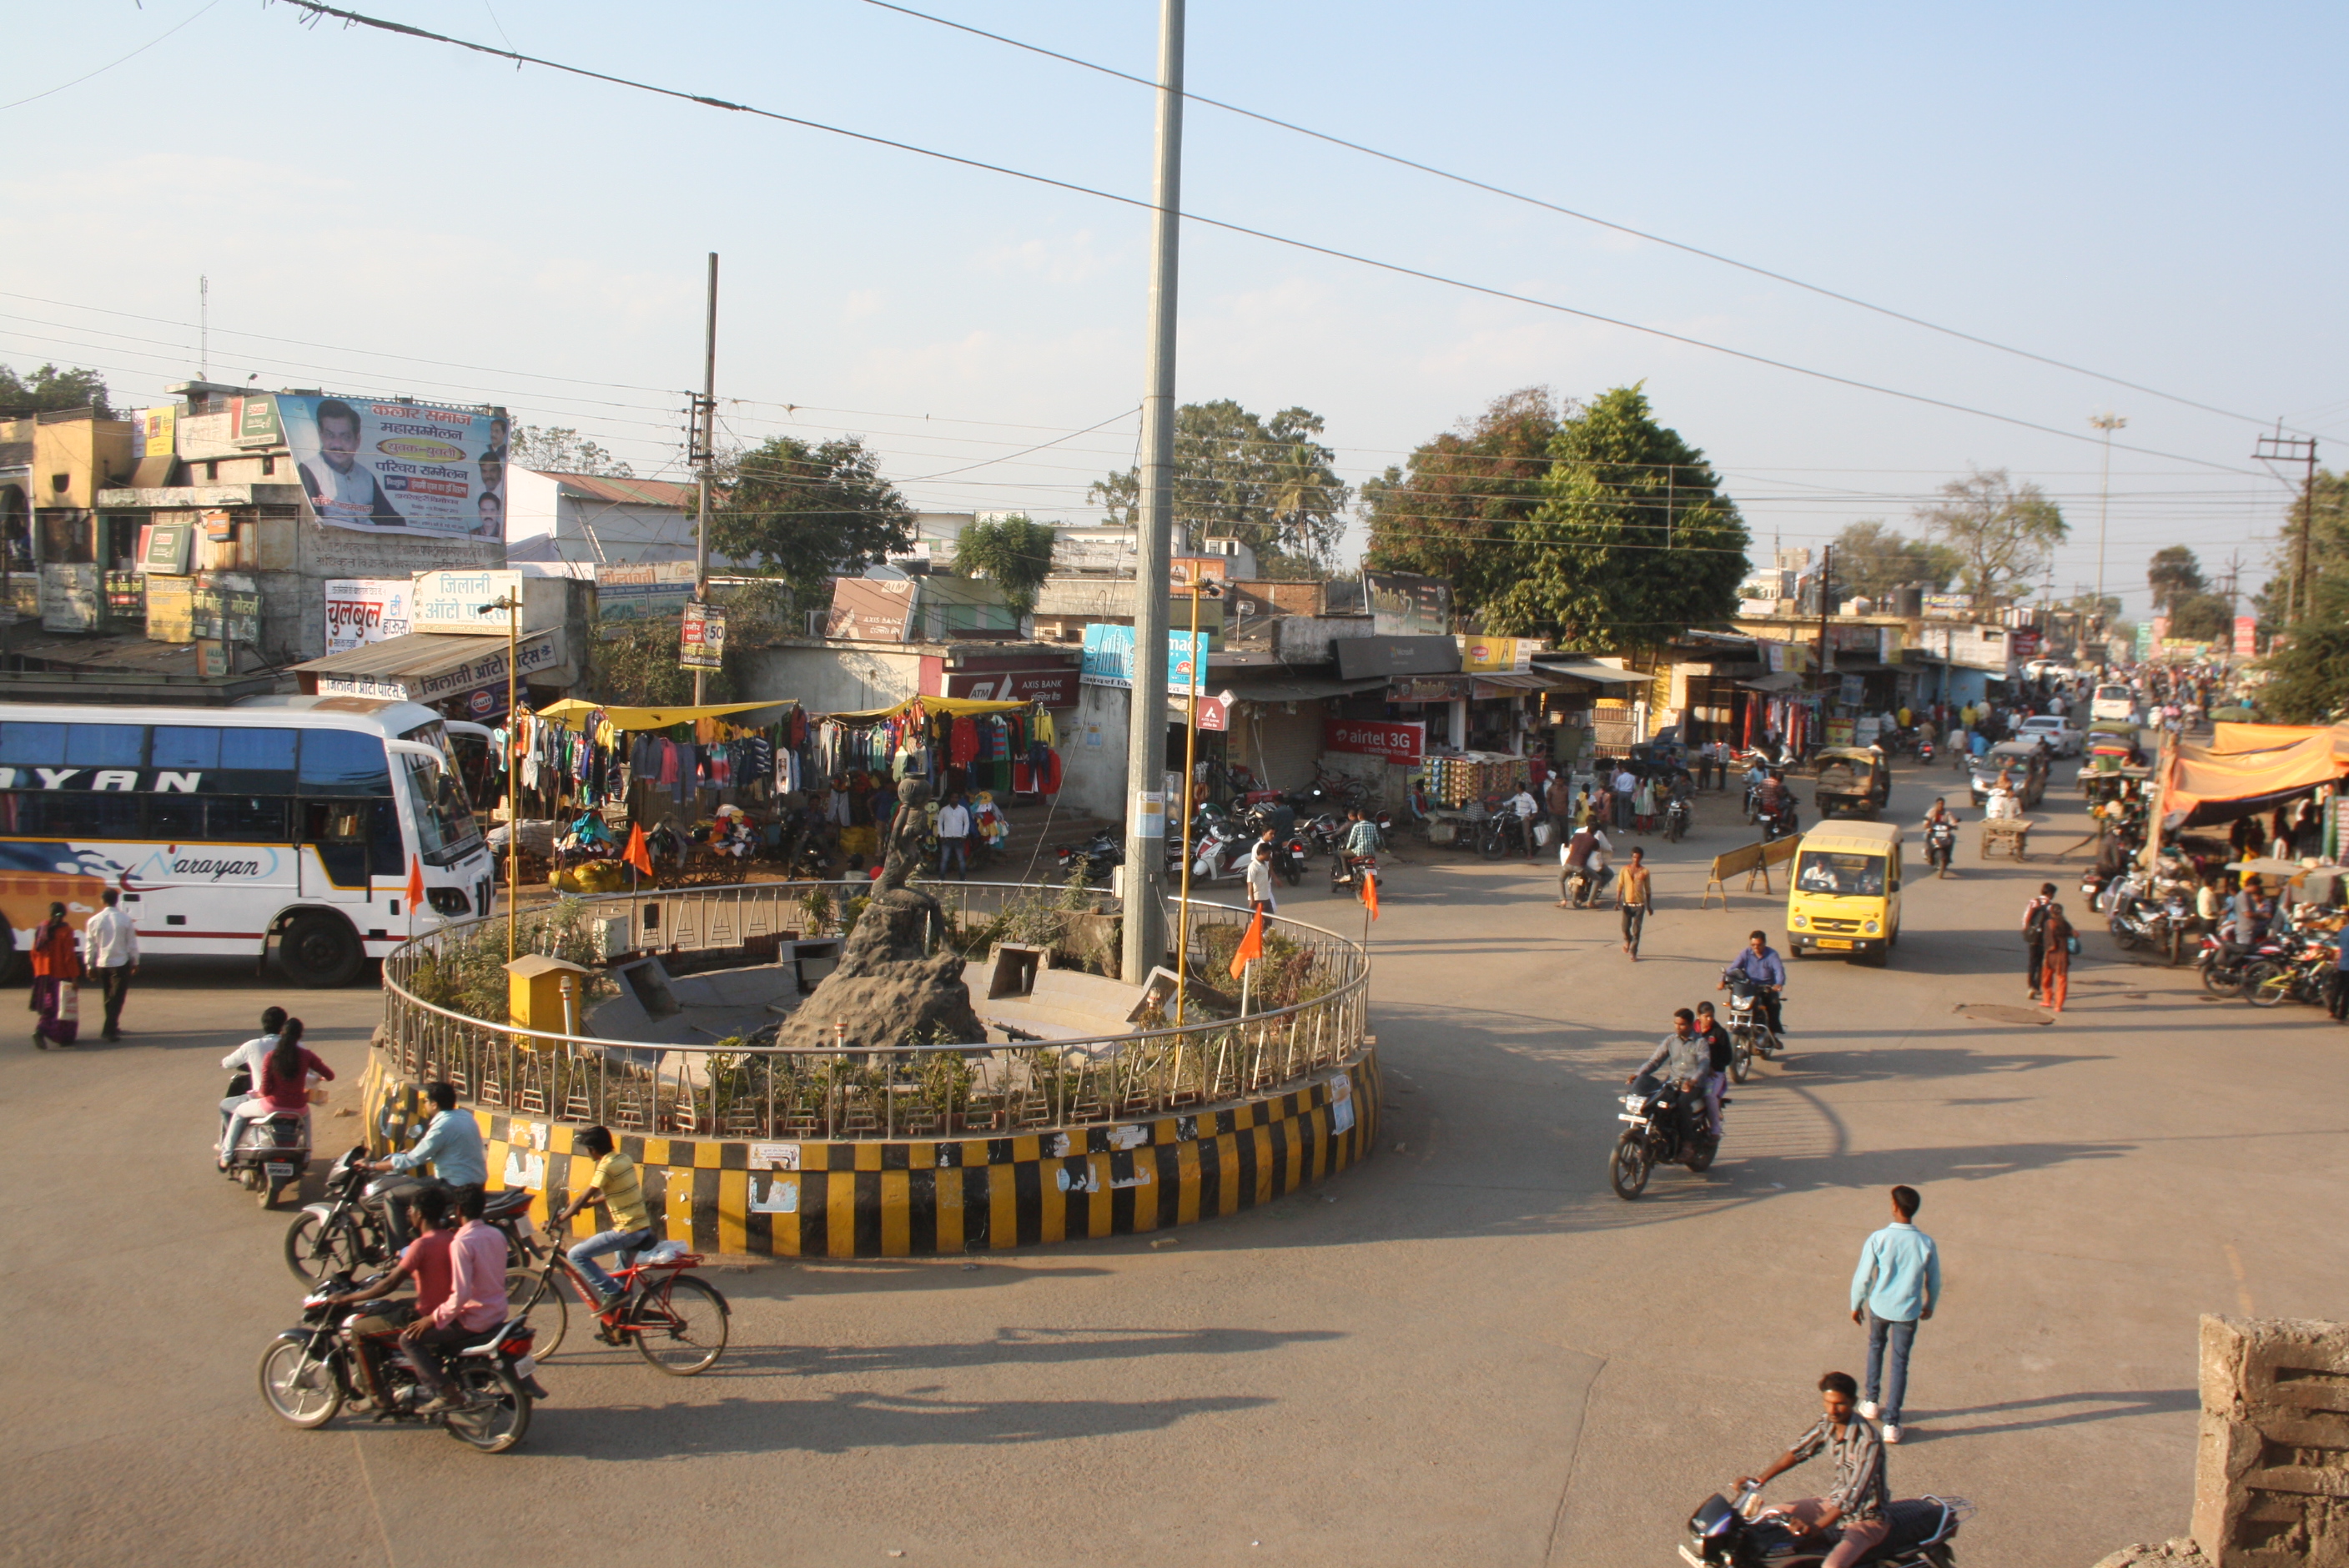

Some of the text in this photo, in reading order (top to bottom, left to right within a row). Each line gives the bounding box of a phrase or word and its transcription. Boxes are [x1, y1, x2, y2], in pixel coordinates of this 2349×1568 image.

[372, 405, 472, 425] कलार समाज
[380, 422, 464, 440] महासम्मेलन
[387, 443, 455, 458] युवक-युवती
[375, 460, 469, 480] परिचय सम्मेलन
[440, 573, 491, 594] जिलानी
[390, 594, 402, 617] टी
[425, 598, 460, 619] ऑटो
[1373, 585, 1407, 613] Balaji
[327, 600, 384, 638] चुलबुल
[420, 664, 471, 696] जिलानी
[475, 653, 504, 680] ऑटो
[1022, 680, 1062, 689] AXIS BANK
[326, 672, 400, 701] जिलानी ऑटो पार्ट्स
[971, 689, 989, 698] ATM
[472, 698, 491, 707] Gulf
[1350, 729, 1410, 748] airtel 3G
[137, 846, 259, 882] Narayan
